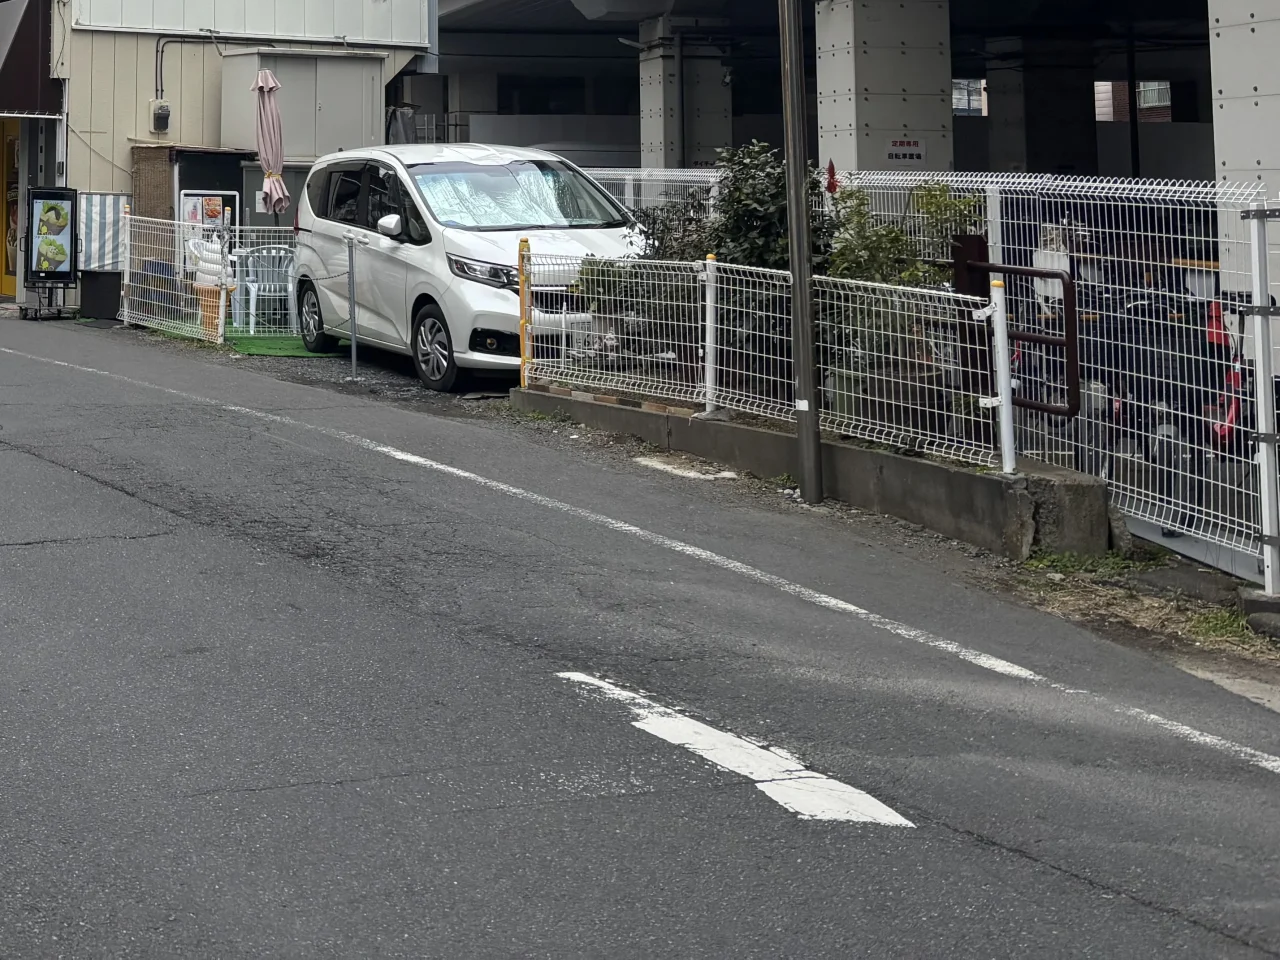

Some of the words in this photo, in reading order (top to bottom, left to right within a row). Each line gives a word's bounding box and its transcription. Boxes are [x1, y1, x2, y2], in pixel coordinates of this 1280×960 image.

[891, 140, 919, 148] 定期専用
[887, 152, 922, 160] 自転車置場
